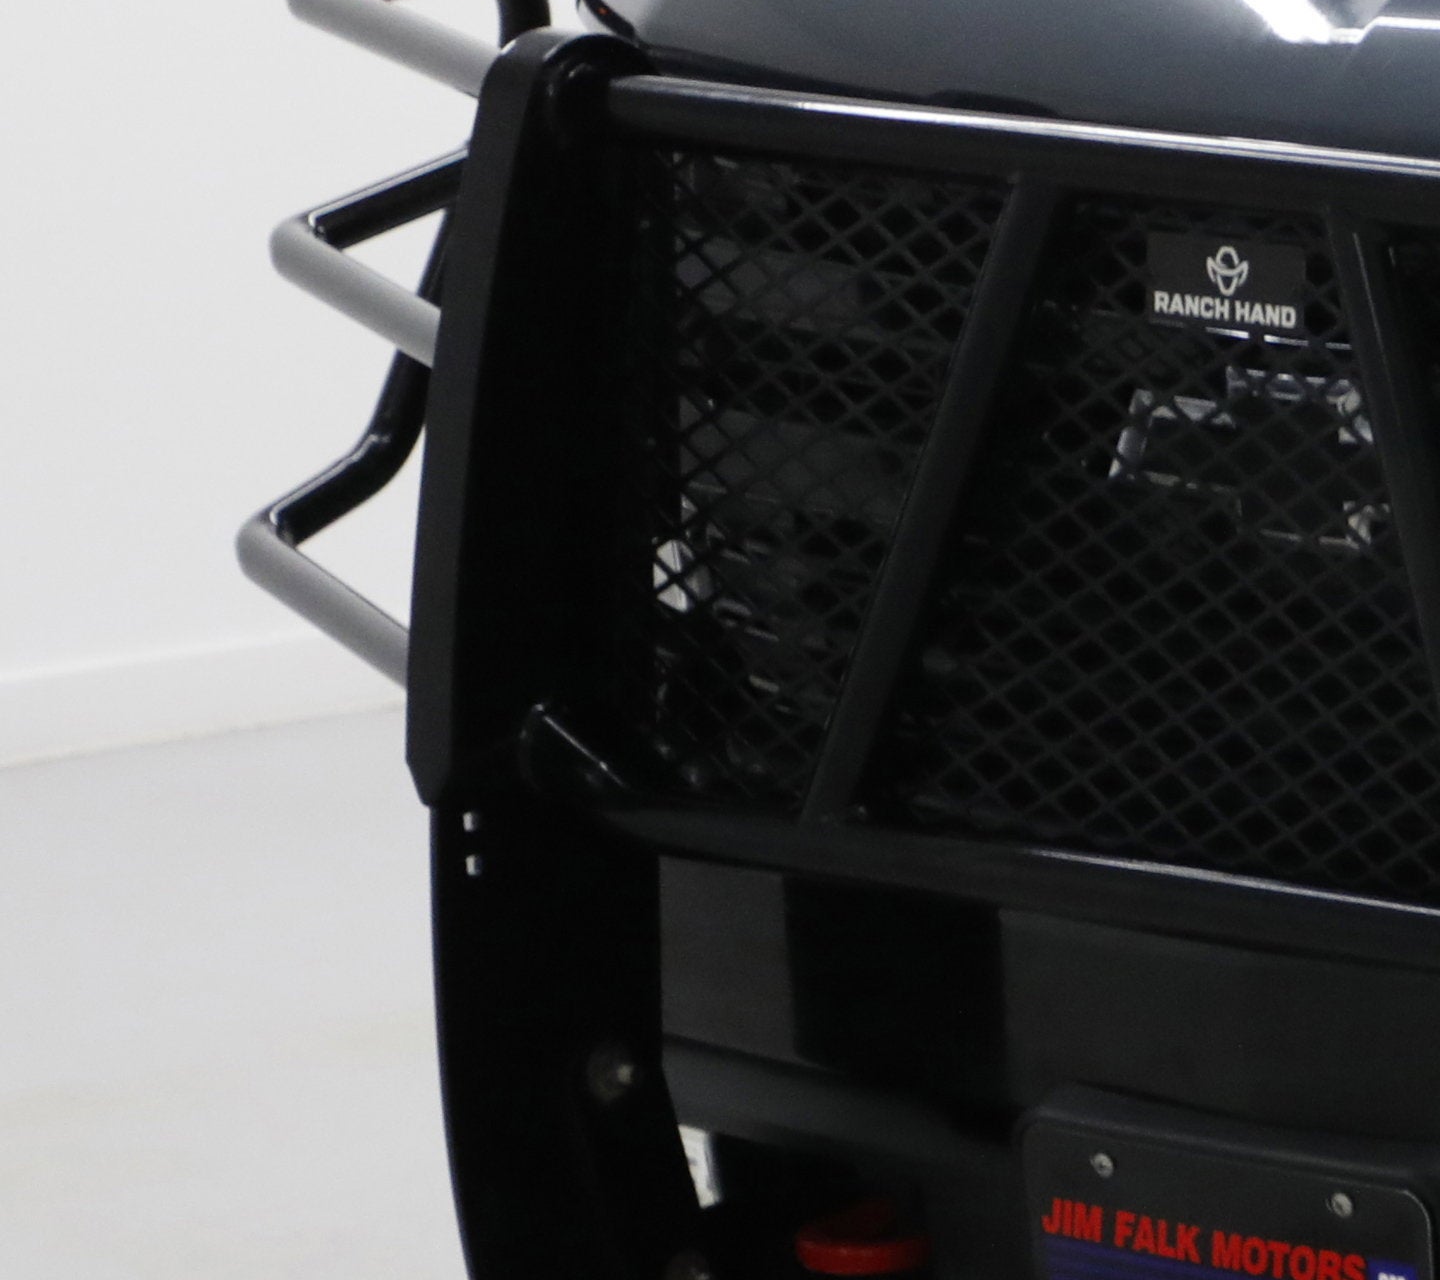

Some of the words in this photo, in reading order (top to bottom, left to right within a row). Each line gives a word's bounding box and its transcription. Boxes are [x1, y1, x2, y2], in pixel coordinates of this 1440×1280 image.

[1153, 290, 1230, 320] RANCH
[1235, 300, 1296, 329] HAND
[1041, 1197, 1103, 1243] JIM
[1113, 1210, 1201, 1264] FALK
